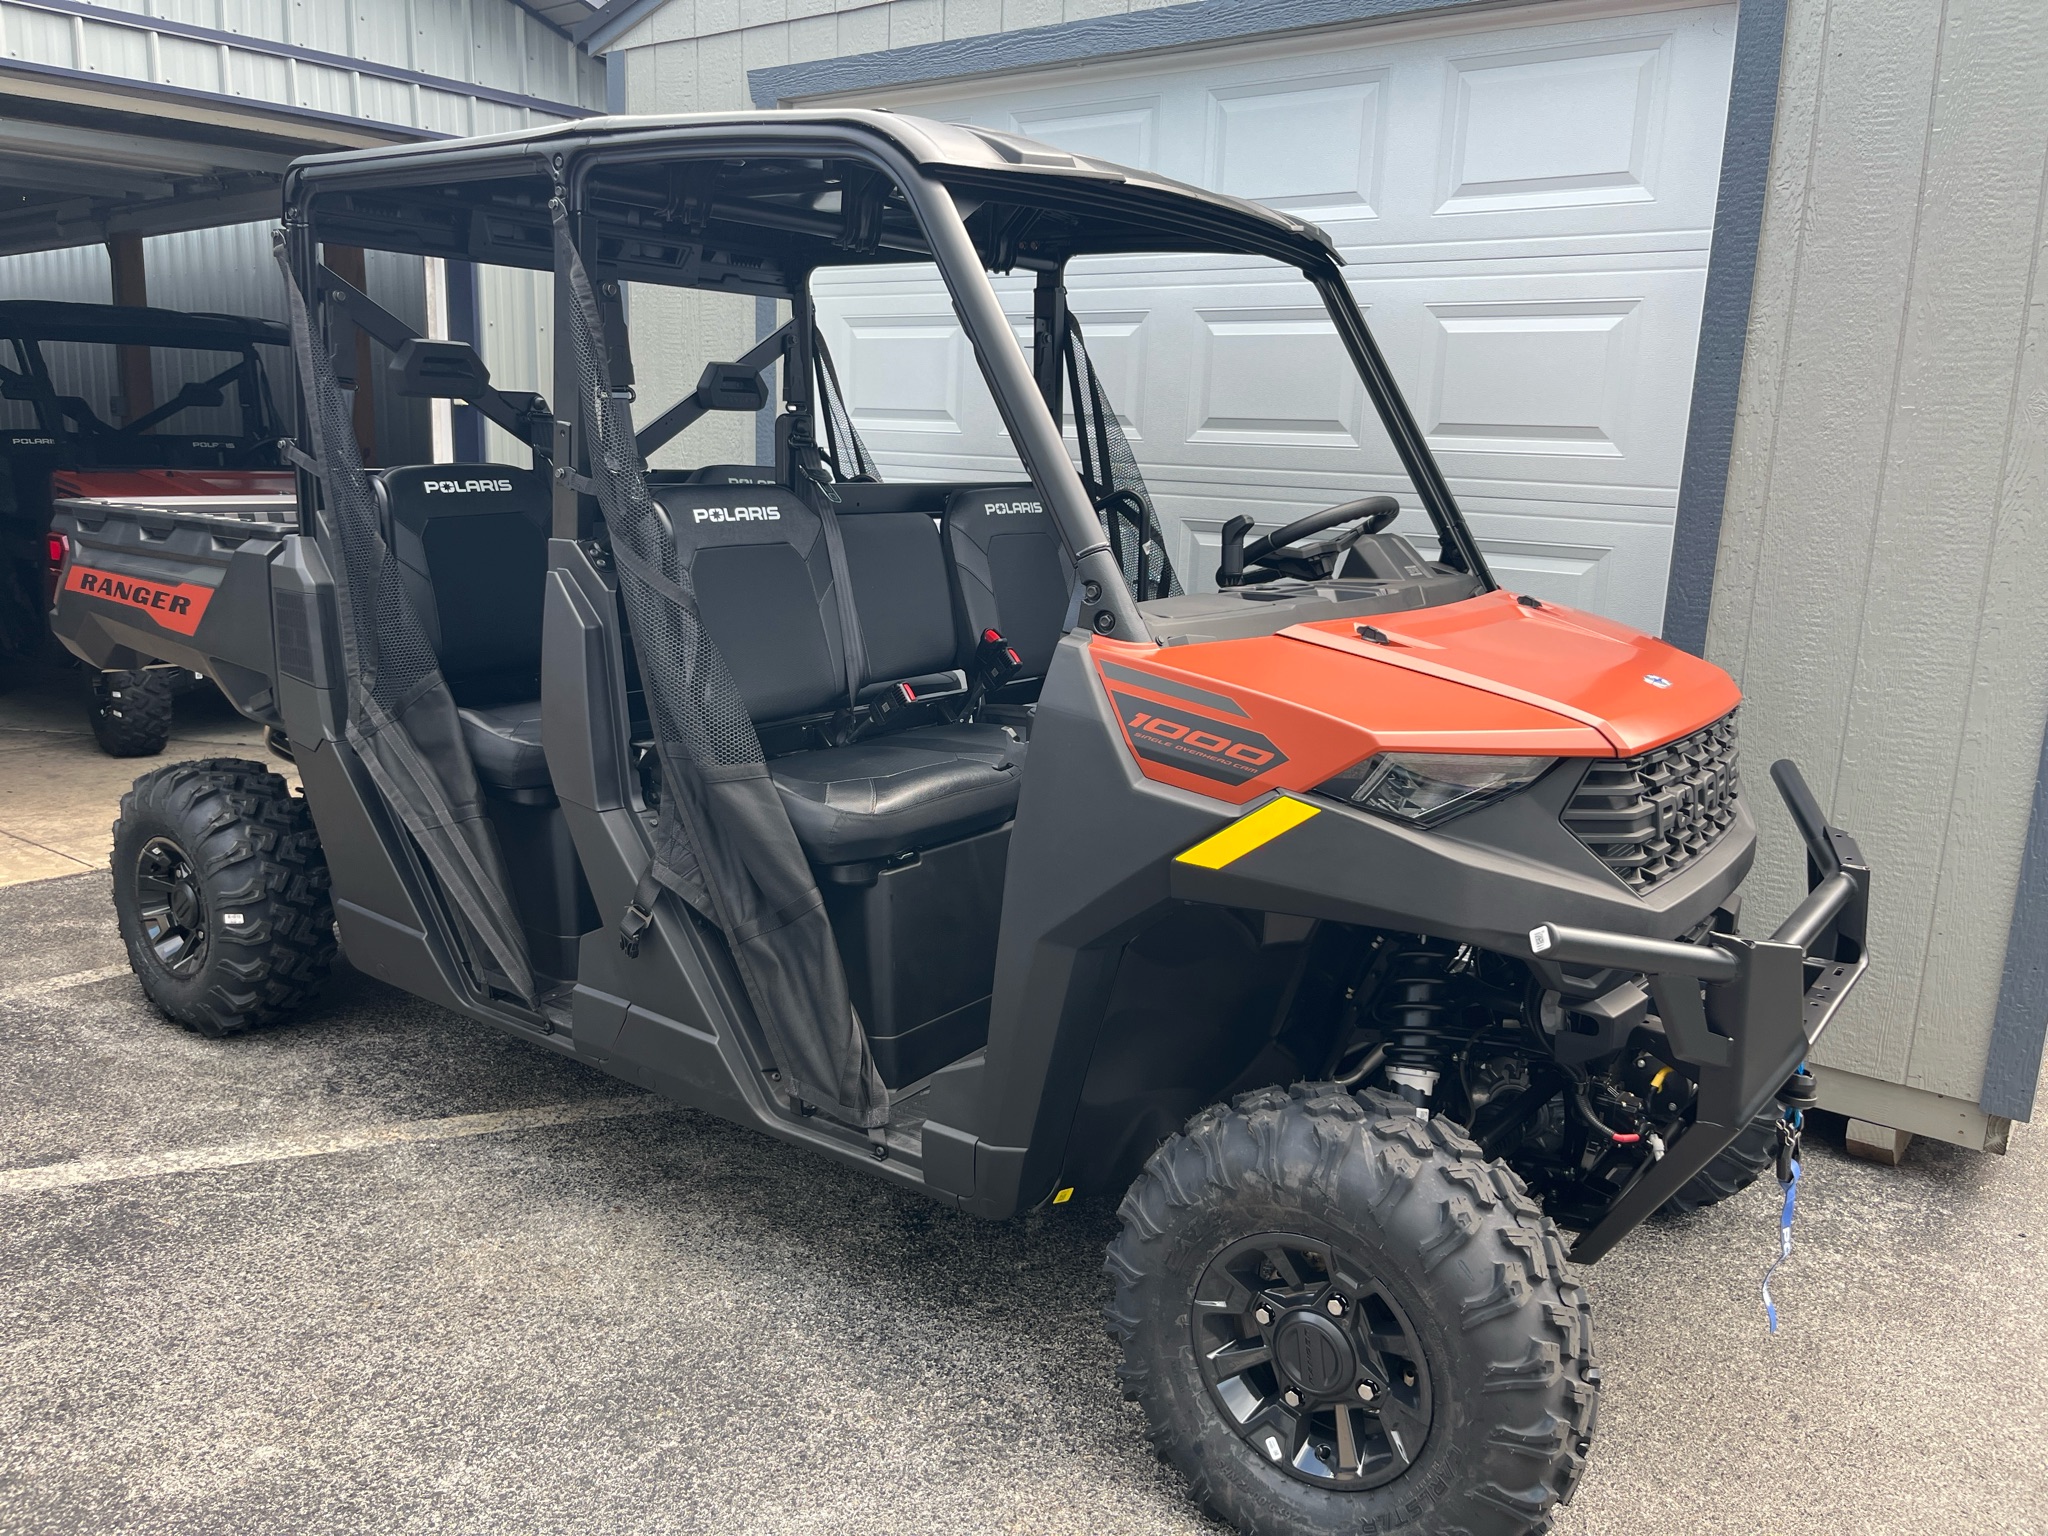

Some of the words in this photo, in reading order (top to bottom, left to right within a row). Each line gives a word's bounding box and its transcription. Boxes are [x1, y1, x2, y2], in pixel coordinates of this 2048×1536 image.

[423, 479, 513, 494] POLARIS
[692, 506, 781, 524] POLARIS
[984, 501, 1043, 516] POLARIS
[79, 572, 192, 616] RANGER
[1127, 712, 1275, 766] 1000
[1133, 732, 1172, 747] SINGLE
[1175, 745, 1232, 764] OVERHEAD
[1232, 762, 1259, 775] CAM
[1359, 1441, 1464, 1535] CARLSTAR
